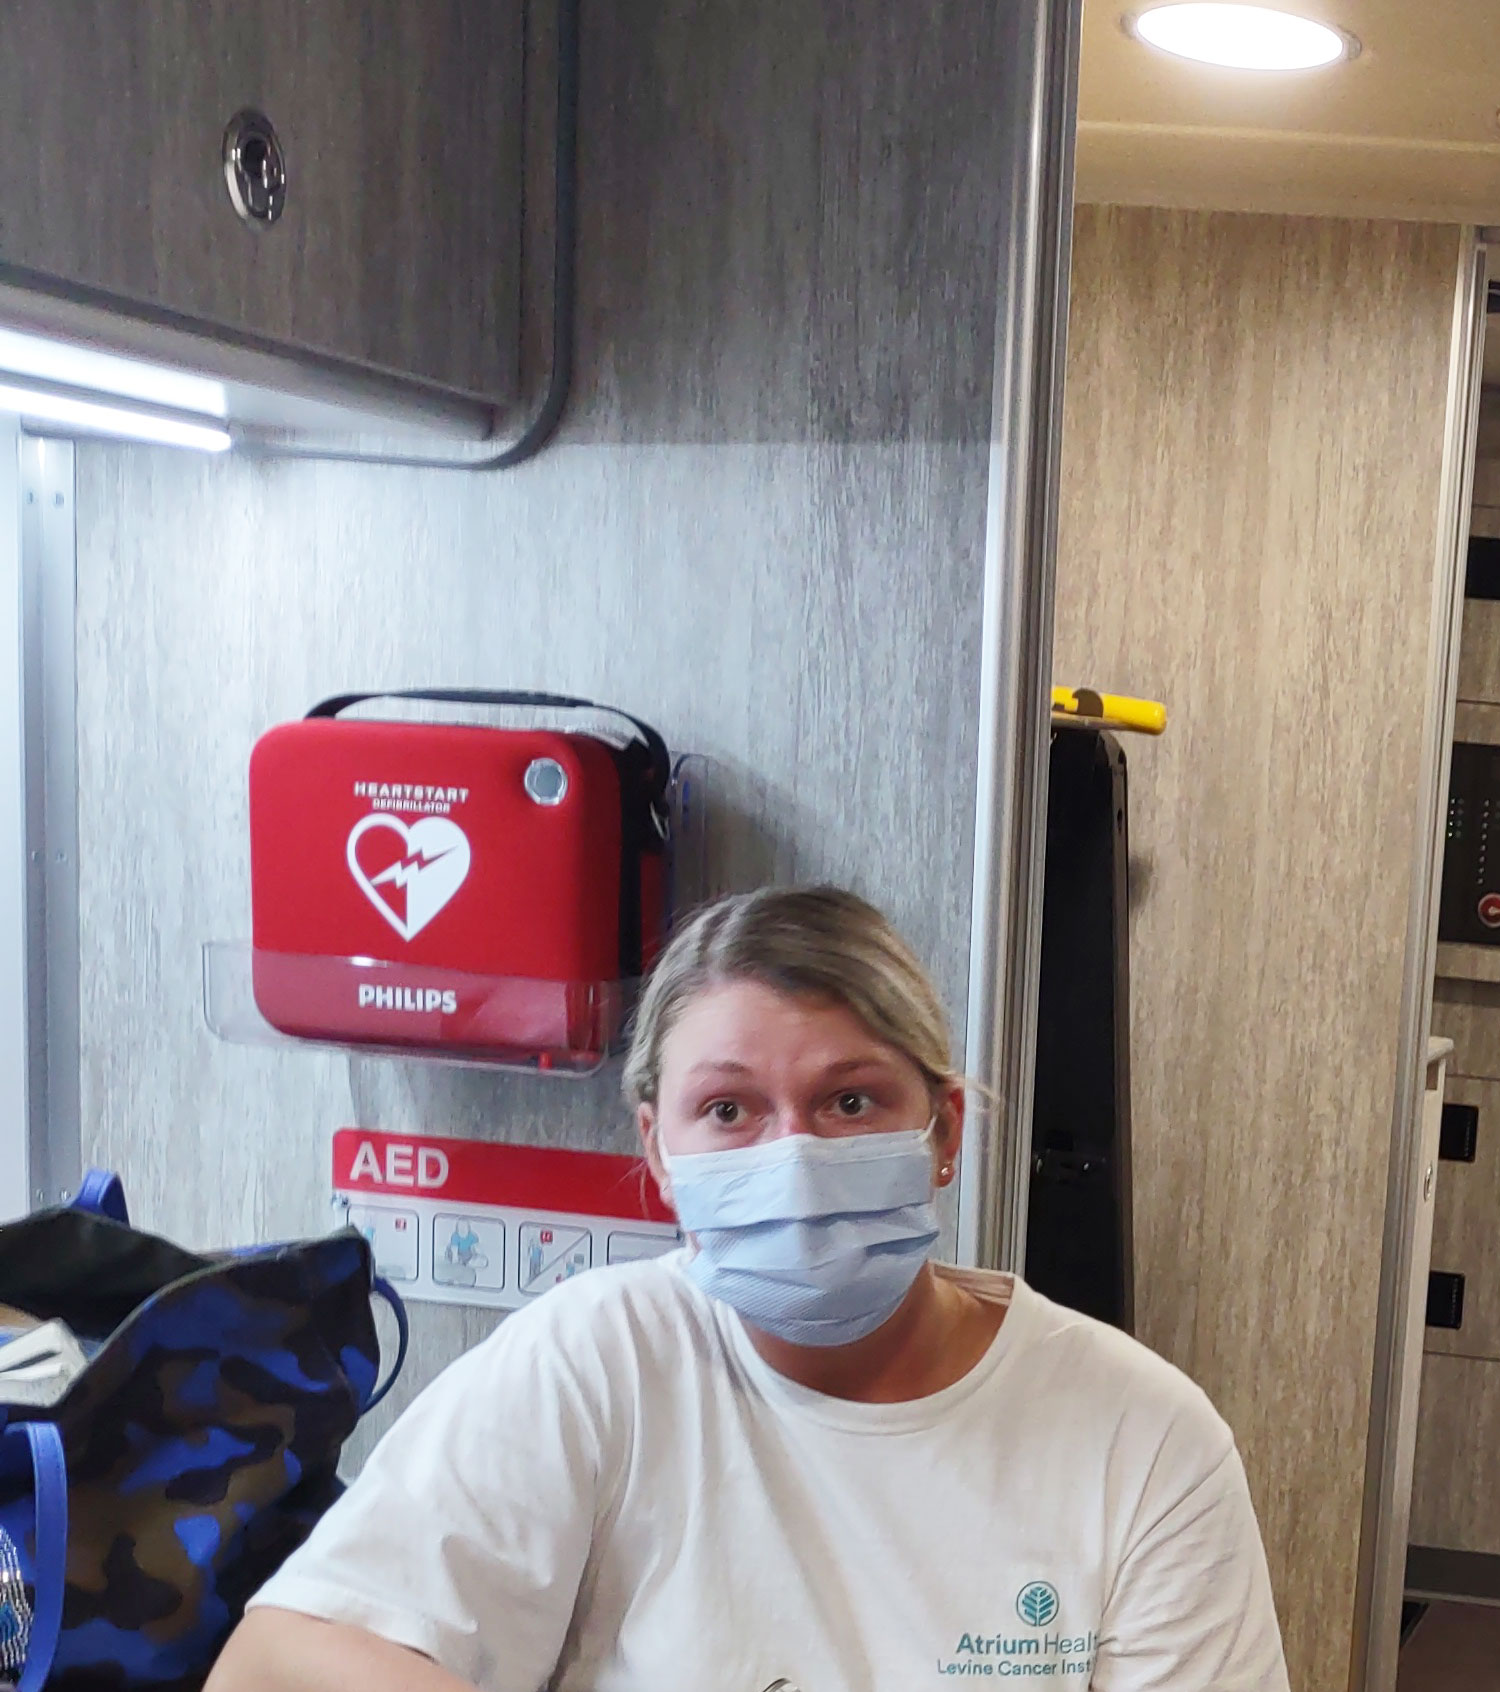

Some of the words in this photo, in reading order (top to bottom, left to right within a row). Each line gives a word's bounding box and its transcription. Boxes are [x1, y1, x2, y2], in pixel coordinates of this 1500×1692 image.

[354, 781, 469, 803] HEARTSTART
[373, 798, 450, 814] DEFIBRILLATOR
[358, 984, 457, 1014] PHILIPS
[350, 1141, 449, 1188] AED
[956, 1633, 1039, 1655] Atrium
[1044, 1632, 1098, 1655] Healt
[937, 1659, 993, 1675] Levine
[998, 1660, 1057, 1676] Cancer
[1062, 1659, 1096, 1674] Inst
